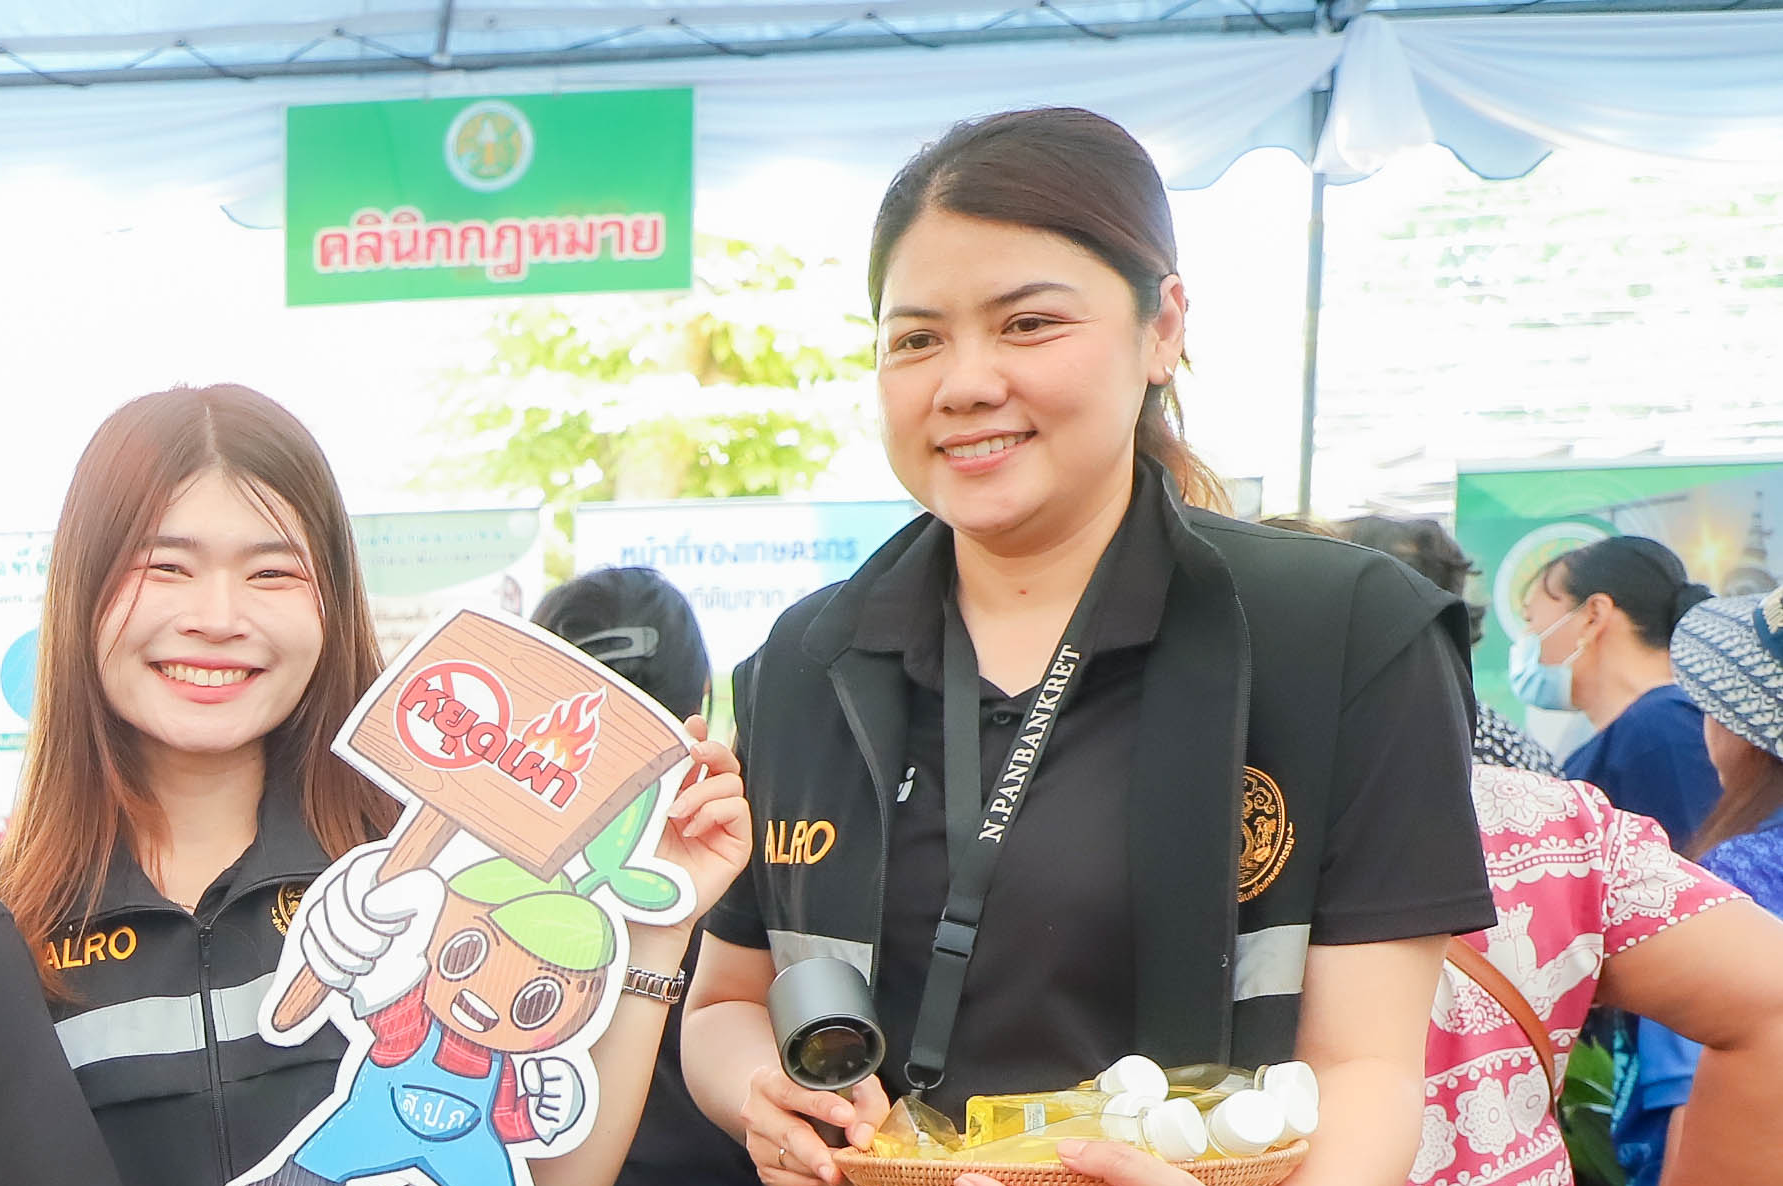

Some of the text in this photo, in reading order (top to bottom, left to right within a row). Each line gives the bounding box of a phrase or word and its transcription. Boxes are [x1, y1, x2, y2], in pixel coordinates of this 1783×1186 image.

[318, 210, 662, 277] คลินิกกฎหมาย
[400, 677, 578, 808] หยุดเผา
[978, 643, 1083, 844] N.PANBANKRET
[764, 819, 837, 865] ALRO
[44, 925, 138, 970] ALRO
[402, 1093, 472, 1130] ส.ป.ก.
